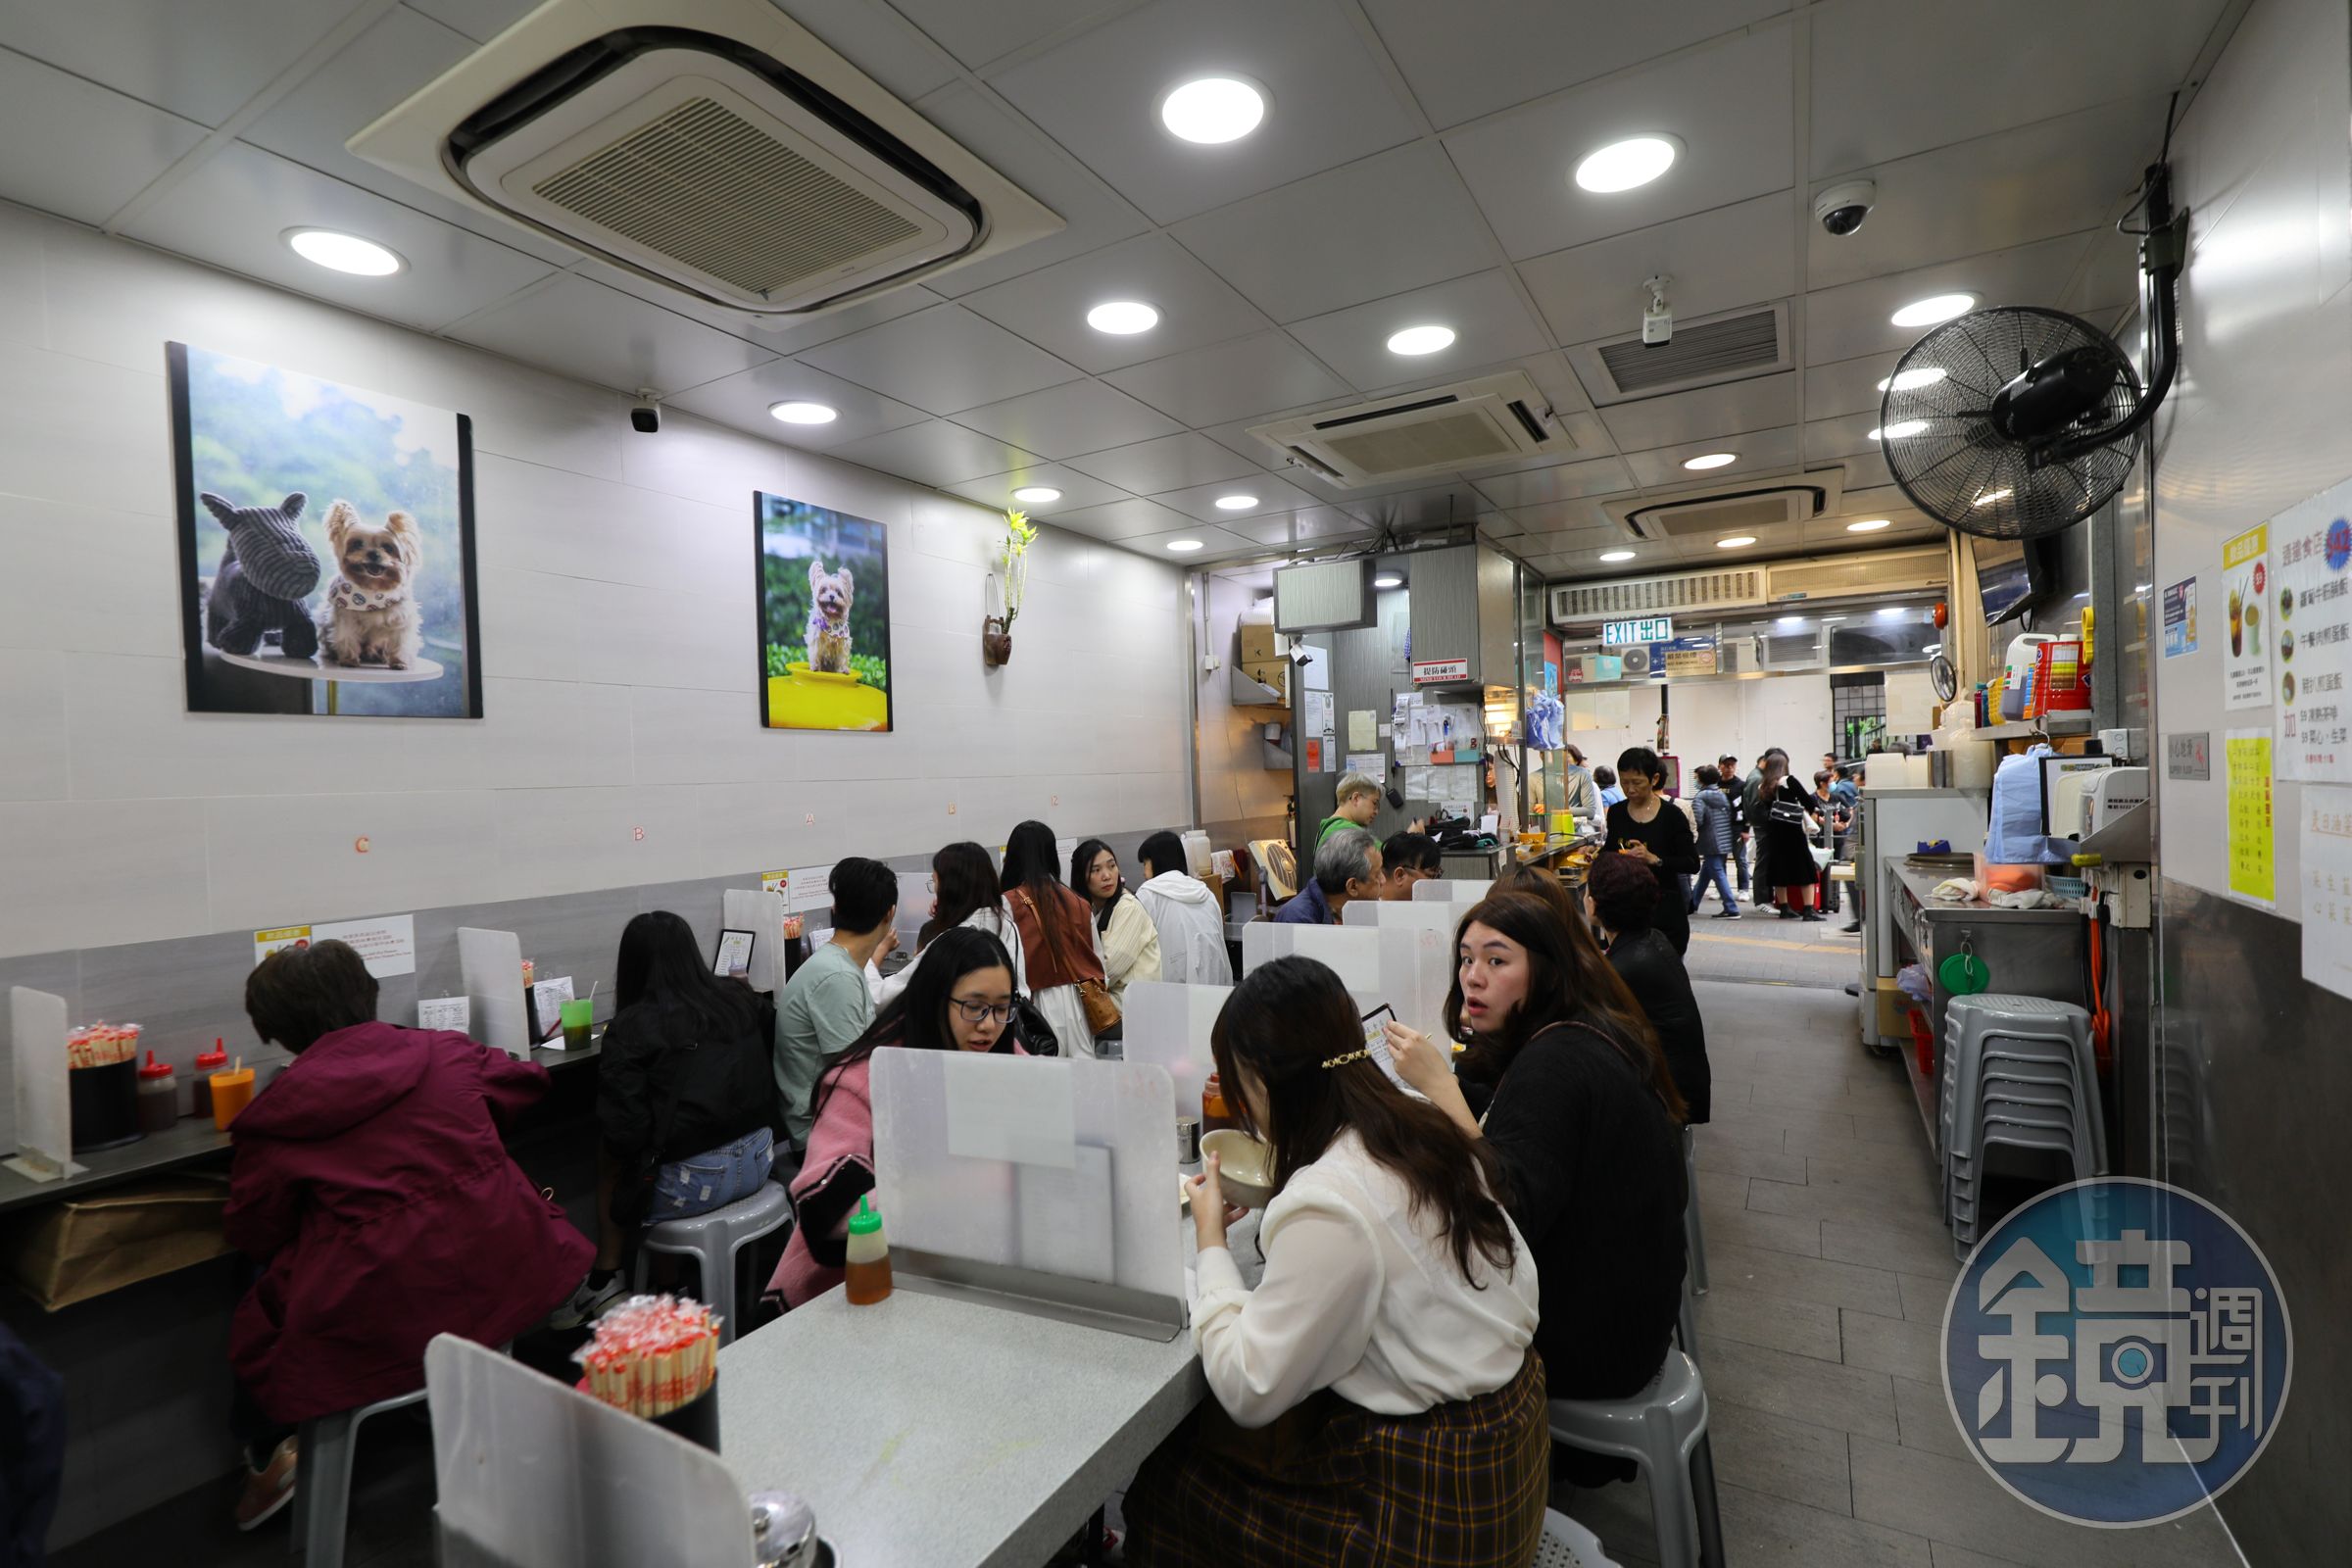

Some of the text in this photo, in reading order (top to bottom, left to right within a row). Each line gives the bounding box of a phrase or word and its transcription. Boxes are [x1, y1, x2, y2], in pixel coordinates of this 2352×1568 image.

[1605, 619, 1668, 645] EXIT 出口
[2283, 710, 2297, 738] 加
[806, 813, 815, 824] A
[633, 826, 645, 841] B
[355, 836, 369, 854] C
